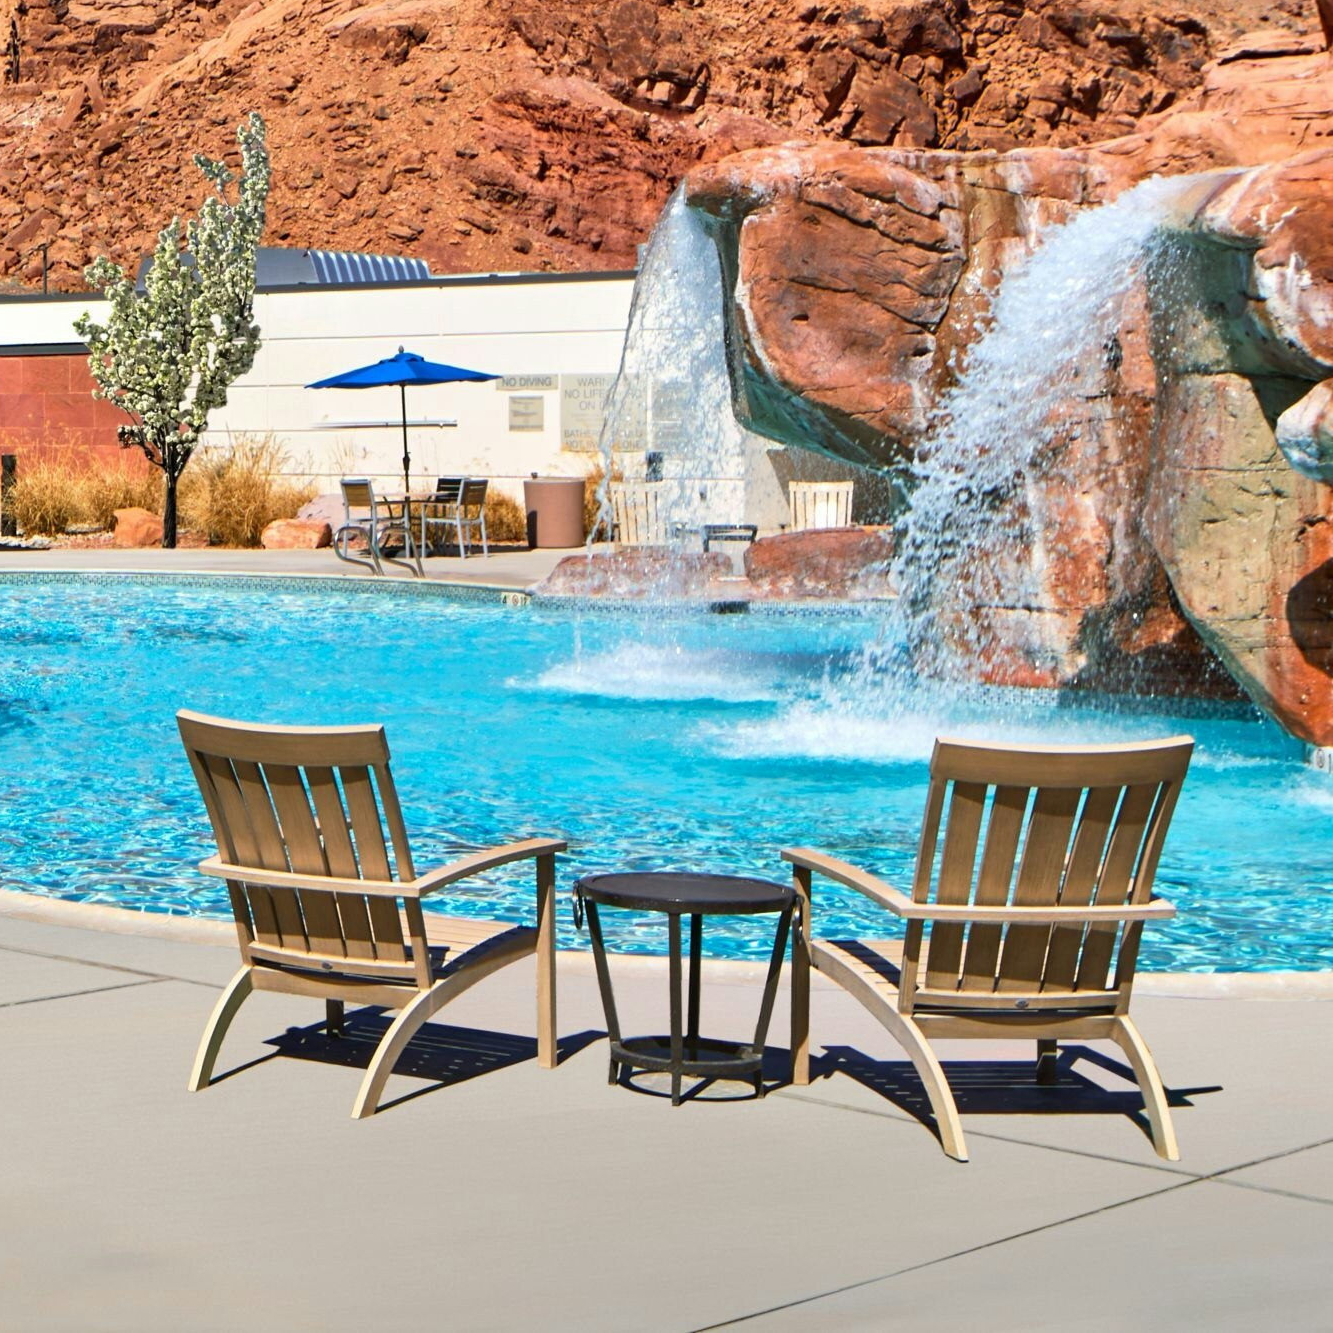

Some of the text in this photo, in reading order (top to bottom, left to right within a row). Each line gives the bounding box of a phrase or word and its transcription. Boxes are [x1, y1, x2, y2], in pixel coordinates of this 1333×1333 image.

[501, 377, 552, 387] NO DIVING
[564, 389, 580, 399] NO
[579, 401, 596, 411] ON
